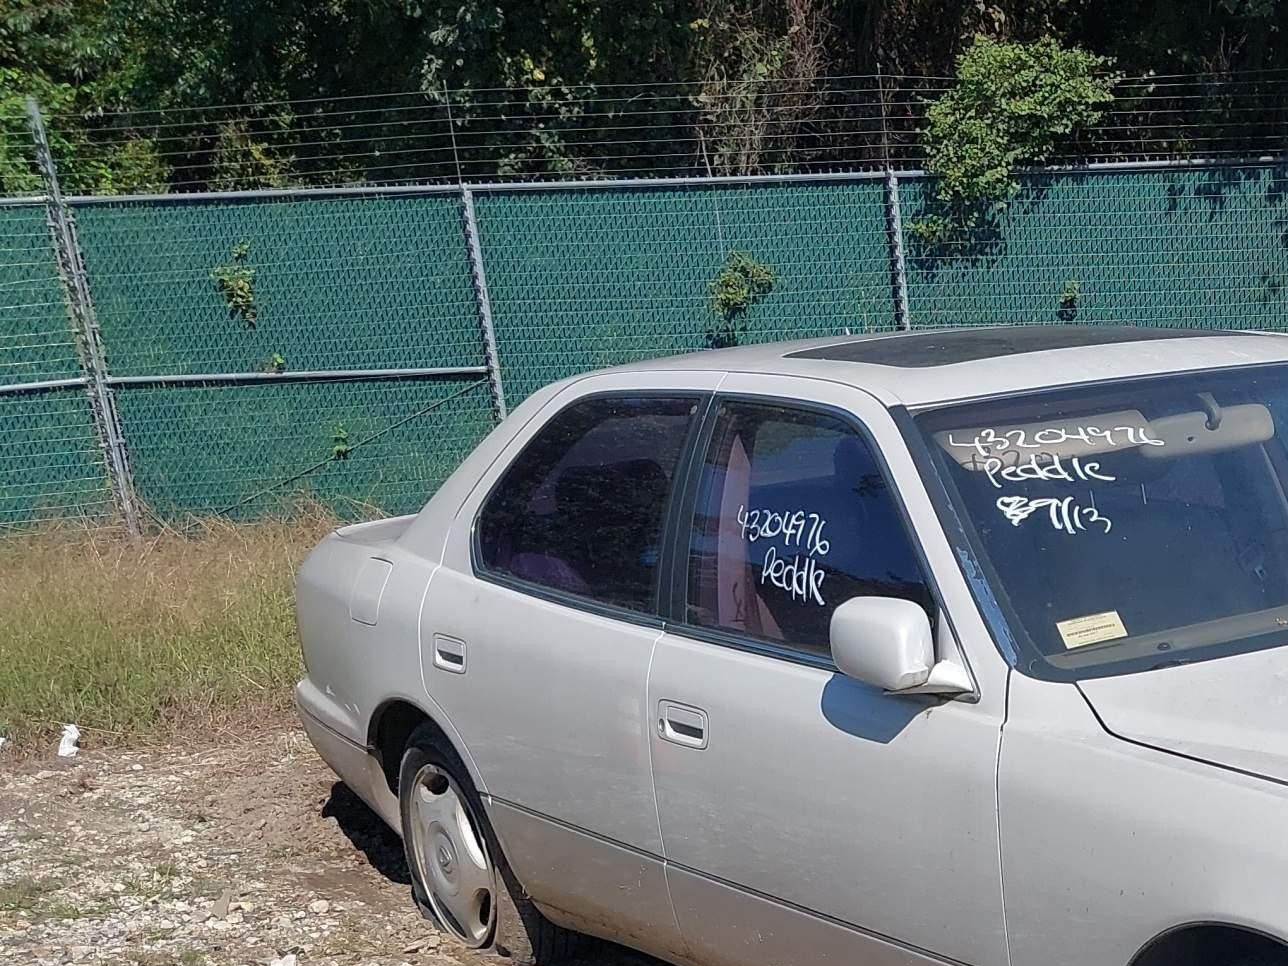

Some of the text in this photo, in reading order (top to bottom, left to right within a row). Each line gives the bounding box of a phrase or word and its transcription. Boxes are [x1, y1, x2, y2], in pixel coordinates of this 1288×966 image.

[948, 426, 1166, 457] 43204976
[983, 454, 1116, 488] Peddle
[736, 504, 830, 556] 43204976
